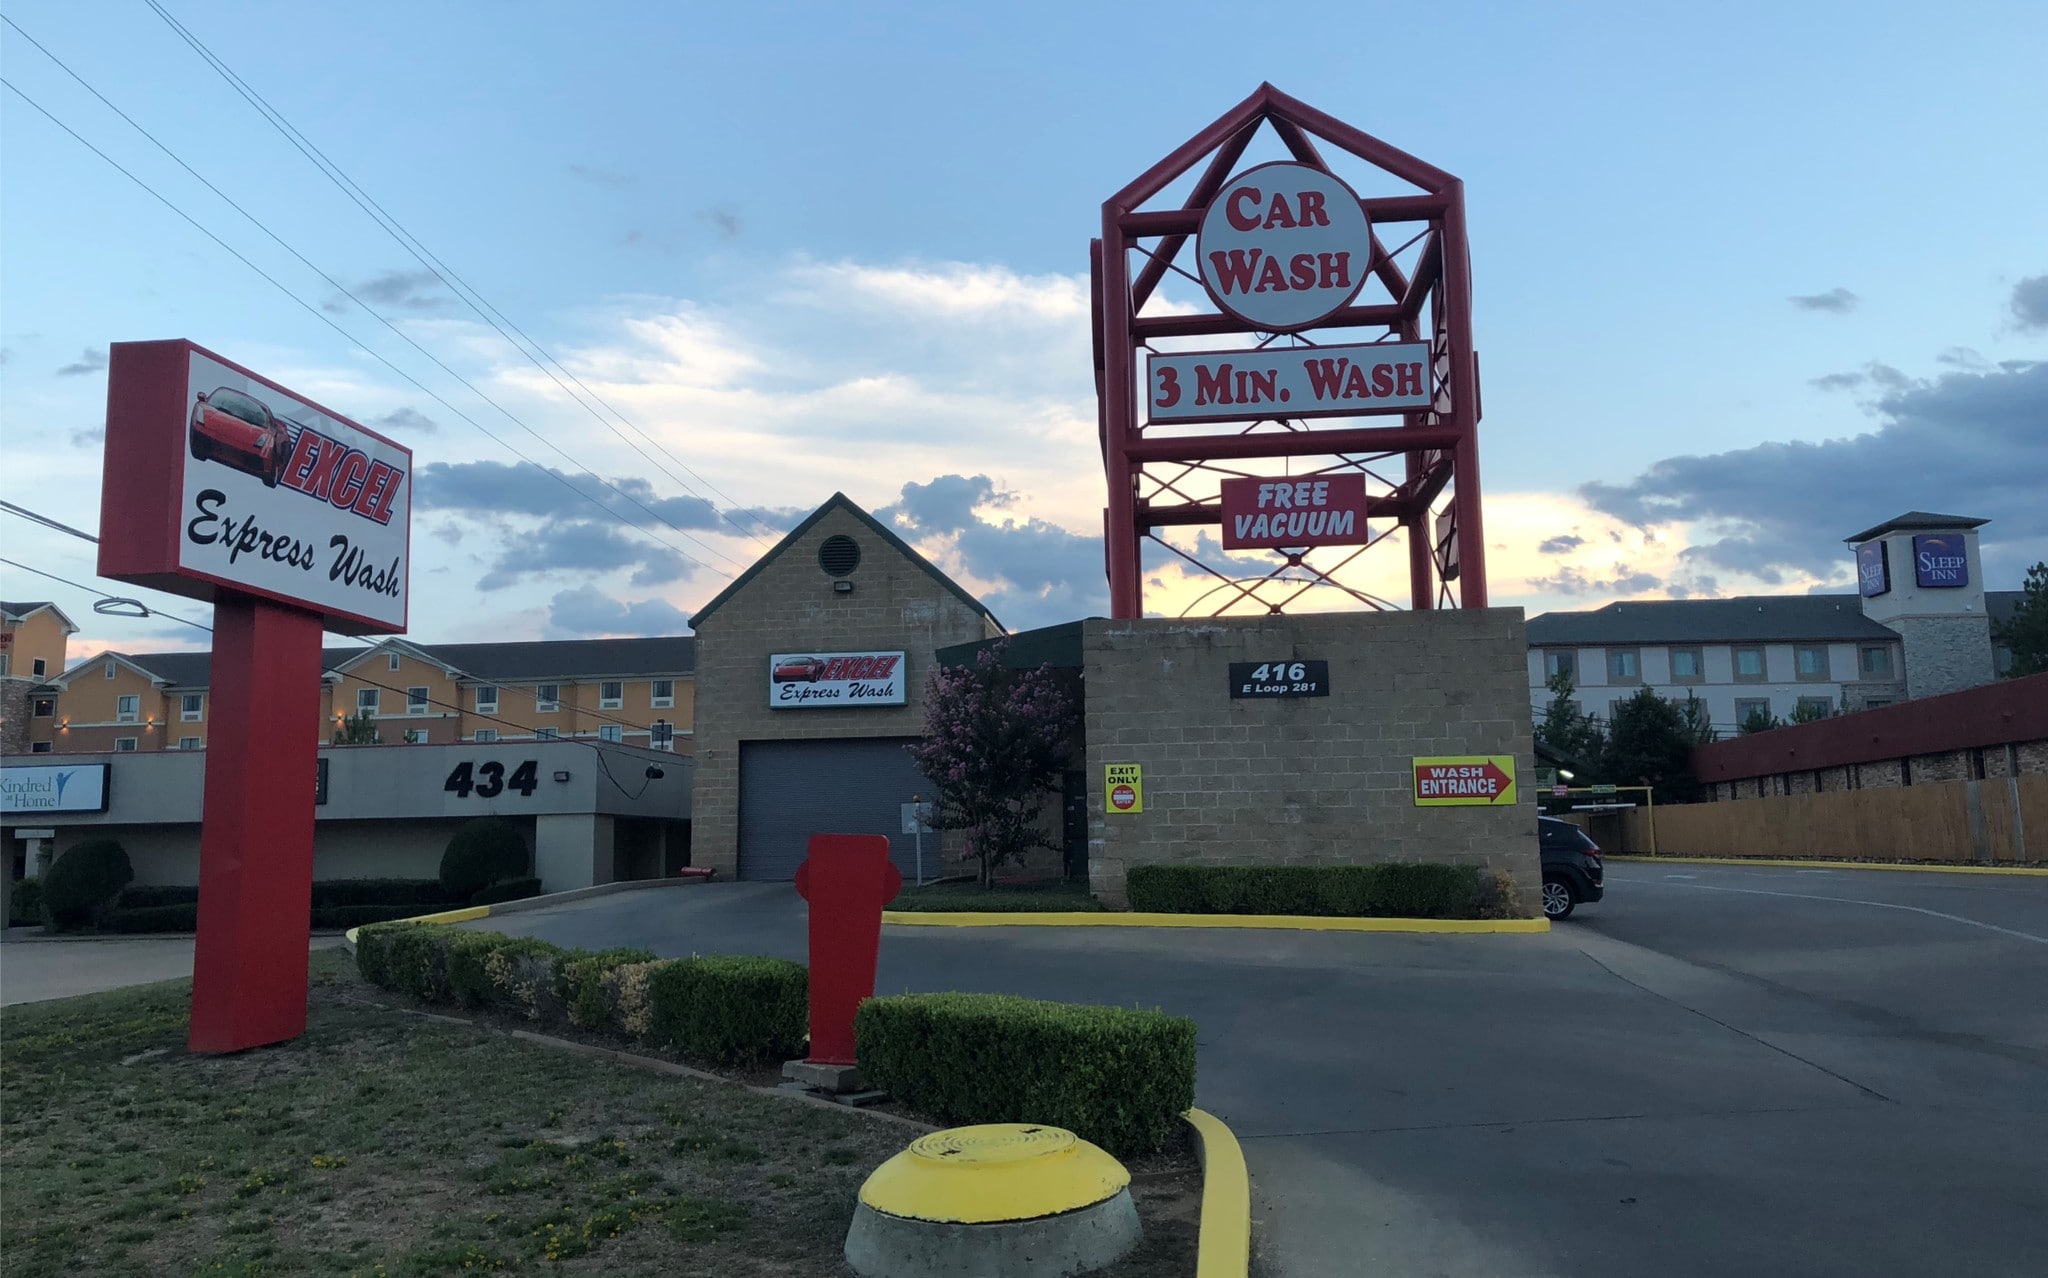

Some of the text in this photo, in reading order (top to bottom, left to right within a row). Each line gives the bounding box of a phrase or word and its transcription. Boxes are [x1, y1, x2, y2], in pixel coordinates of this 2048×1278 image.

[1226, 187, 1331, 232] CAR
[1209, 248, 1352, 296] WASH
[1155, 357, 1424, 408] 3 MIN. WASH
[277, 425, 406, 527] EXCEL
[1257, 481, 1330, 509] FREE
[1234, 510, 1355, 540] VACUUM
[187, 488, 401, 598] Express Wash
[1919, 551, 1965, 572] SLEEP
[1860, 563, 1883, 583] SLEEP
[1866, 576, 1881, 591] INN
[1931, 569, 1958, 580] INN
[820, 655, 902, 681] EXCEL
[1251, 662, 1306, 681] 416
[780, 681, 894, 702] Express Wash
[1242, 682, 1317, 694] E Loop 281
[443, 760, 539, 799] 434
[1108, 776, 1138, 784] ONLY
[1110, 767, 1136, 775] EXIT
[1430, 767, 1484, 778] WASH
[1421, 778, 1497, 795] ENTRANCE
[14, 793, 56, 808] Home
